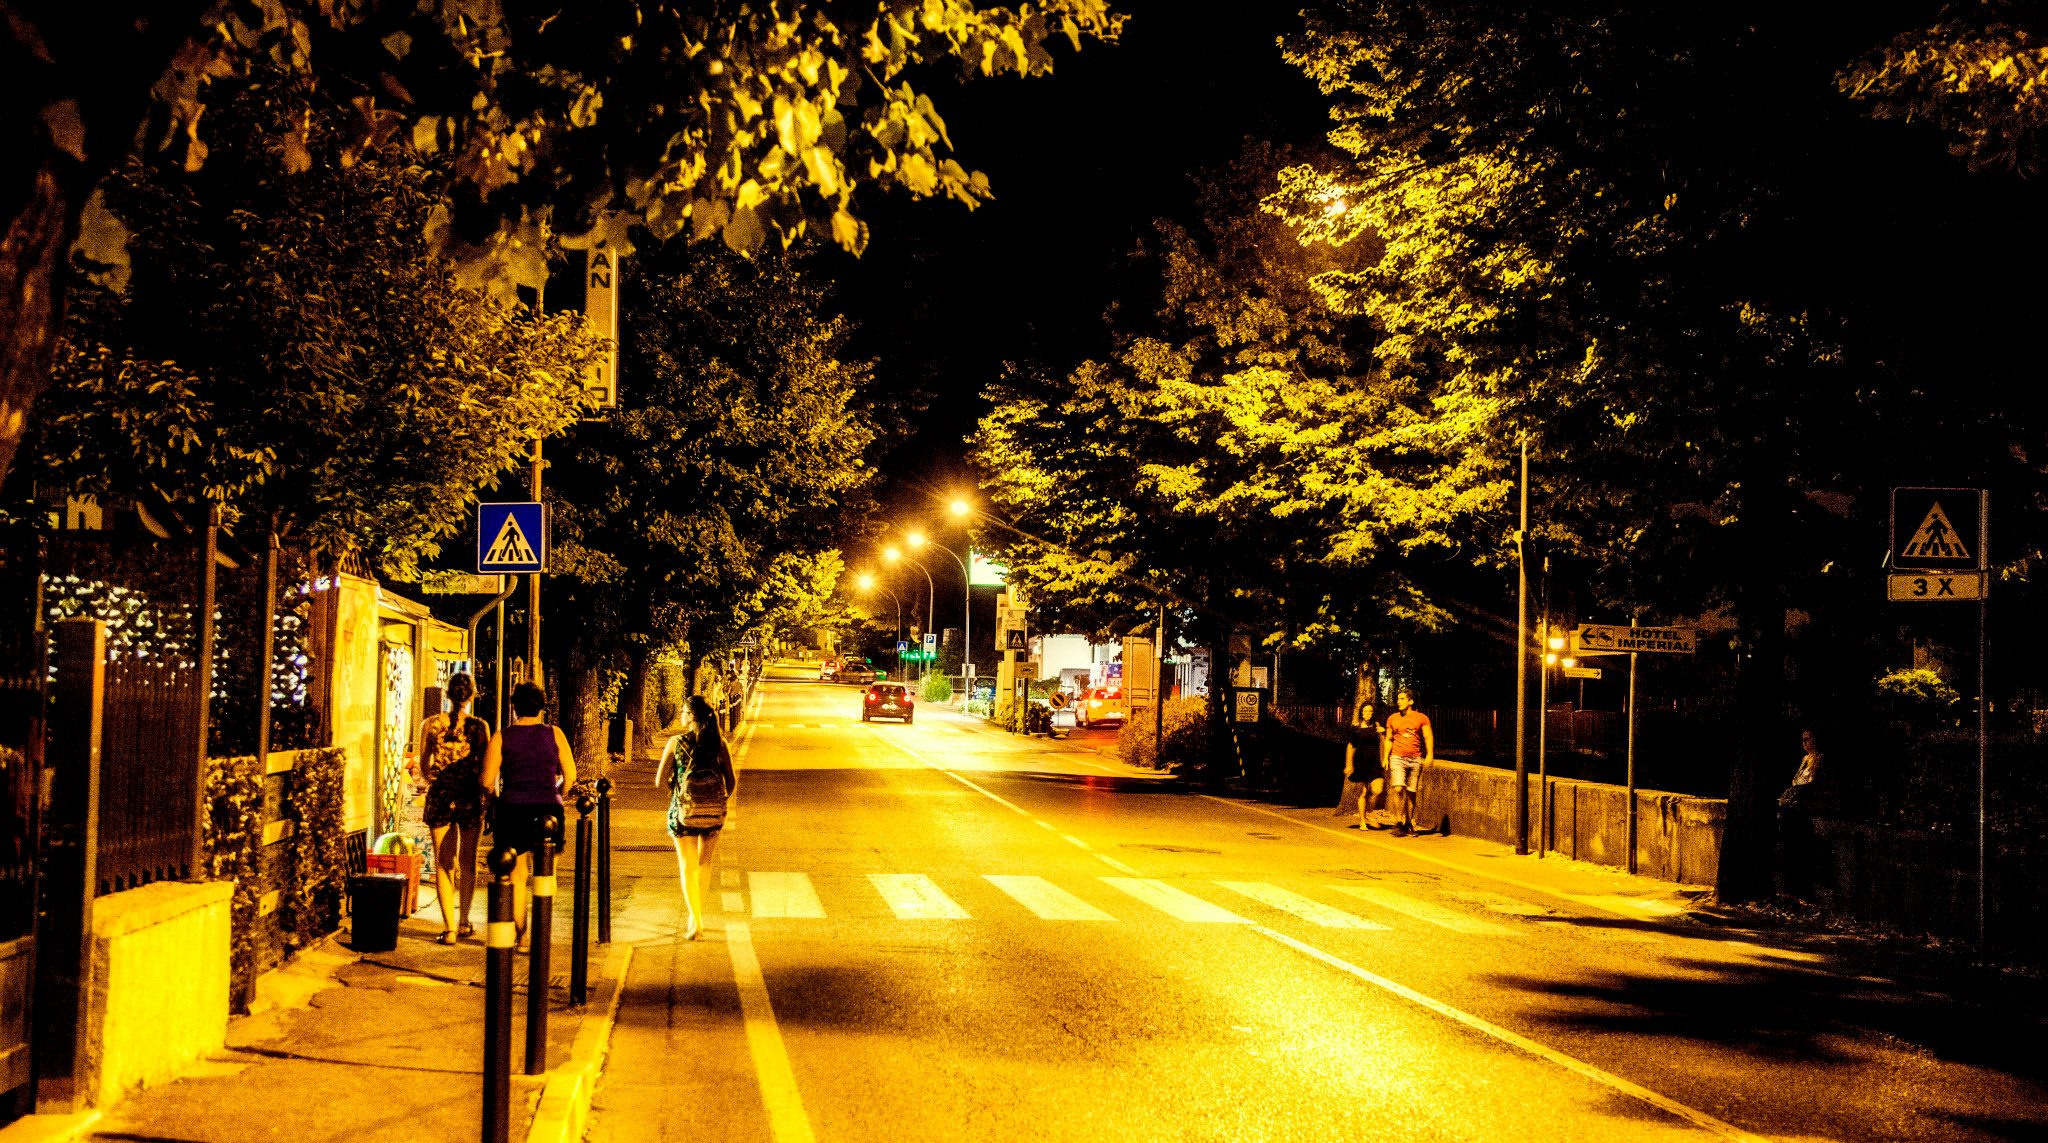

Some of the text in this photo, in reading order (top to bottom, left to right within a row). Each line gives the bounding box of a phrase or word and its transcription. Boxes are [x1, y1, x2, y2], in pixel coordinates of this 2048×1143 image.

[590, 240, 611, 288] AN
[1913, 578, 1955, 596] 3 X
[1016, 593, 1026, 603] 30
[1629, 629, 1682, 641] HOTEL
[1617, 639, 1693, 651] IMPERIAL
